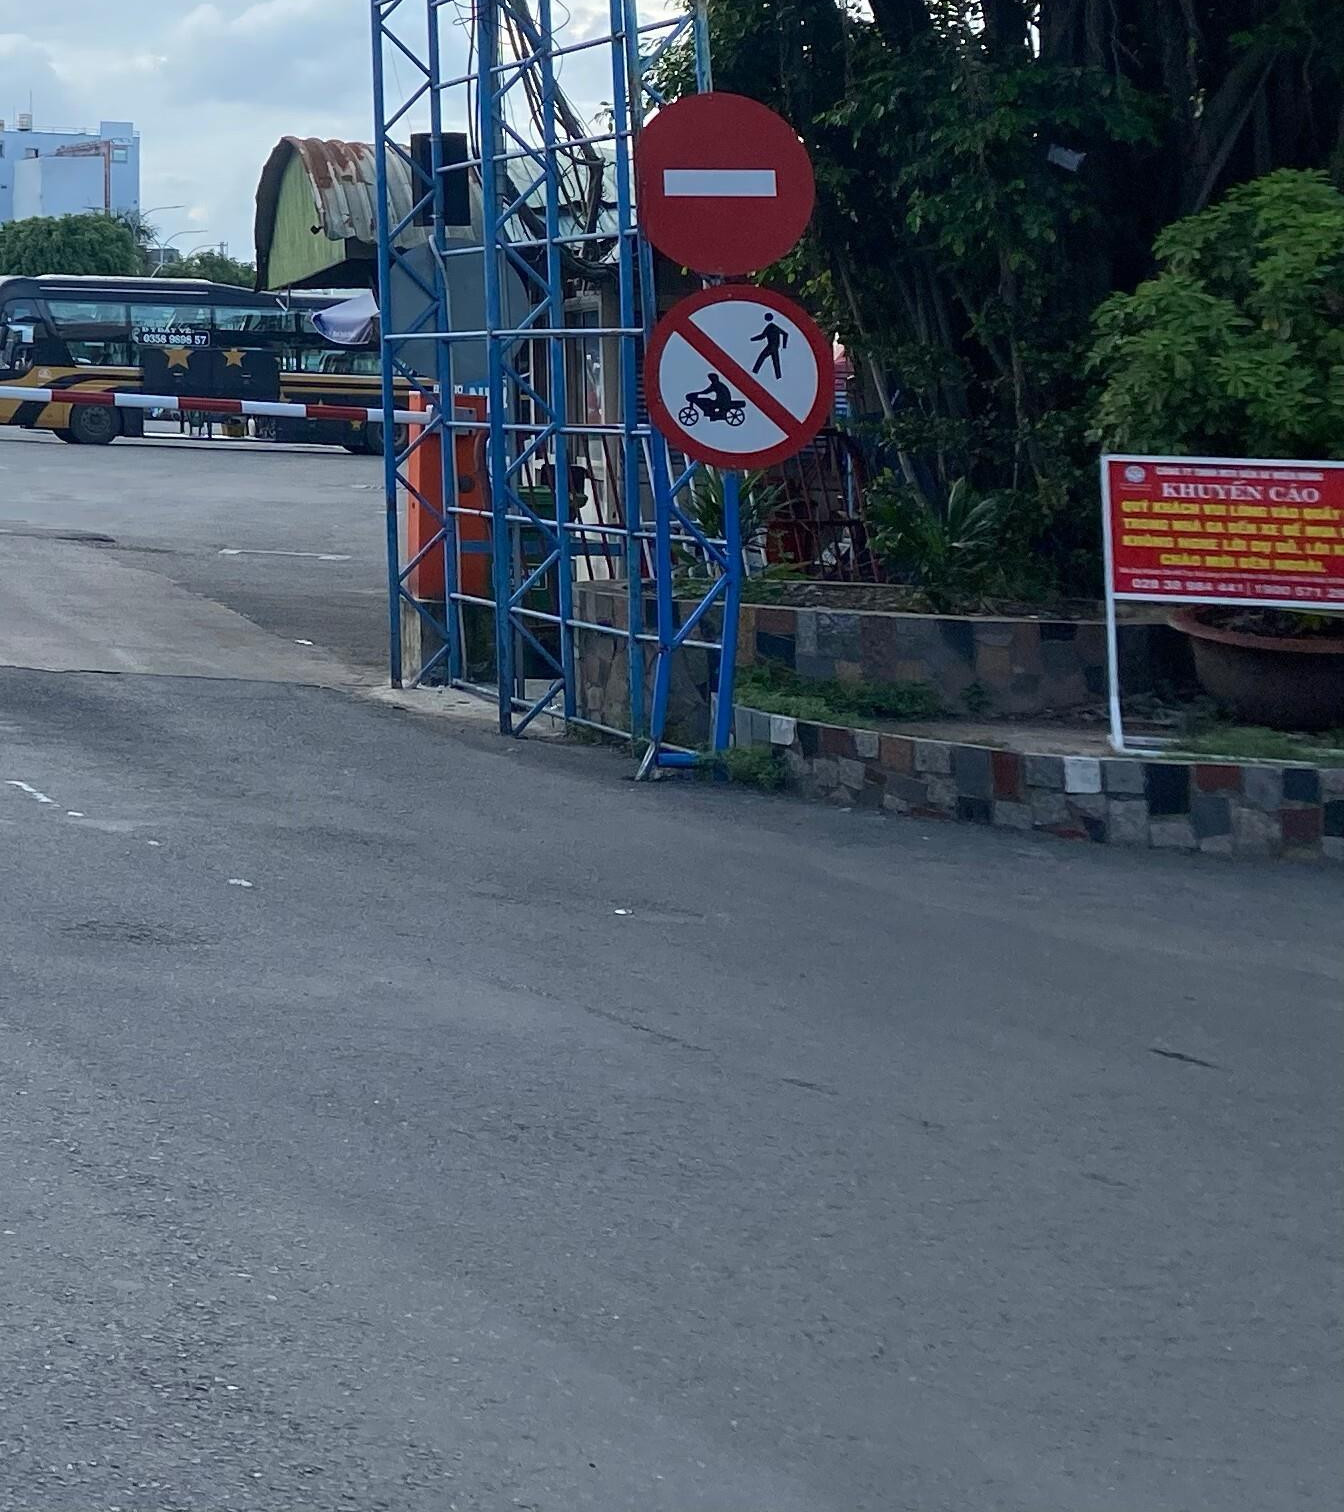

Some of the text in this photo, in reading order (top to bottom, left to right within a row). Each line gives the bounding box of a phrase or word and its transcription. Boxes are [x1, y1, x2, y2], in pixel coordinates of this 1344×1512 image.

[194, 335, 207, 345] 57
[1162, 480, 1321, 504] KHUYẾN CÁO
